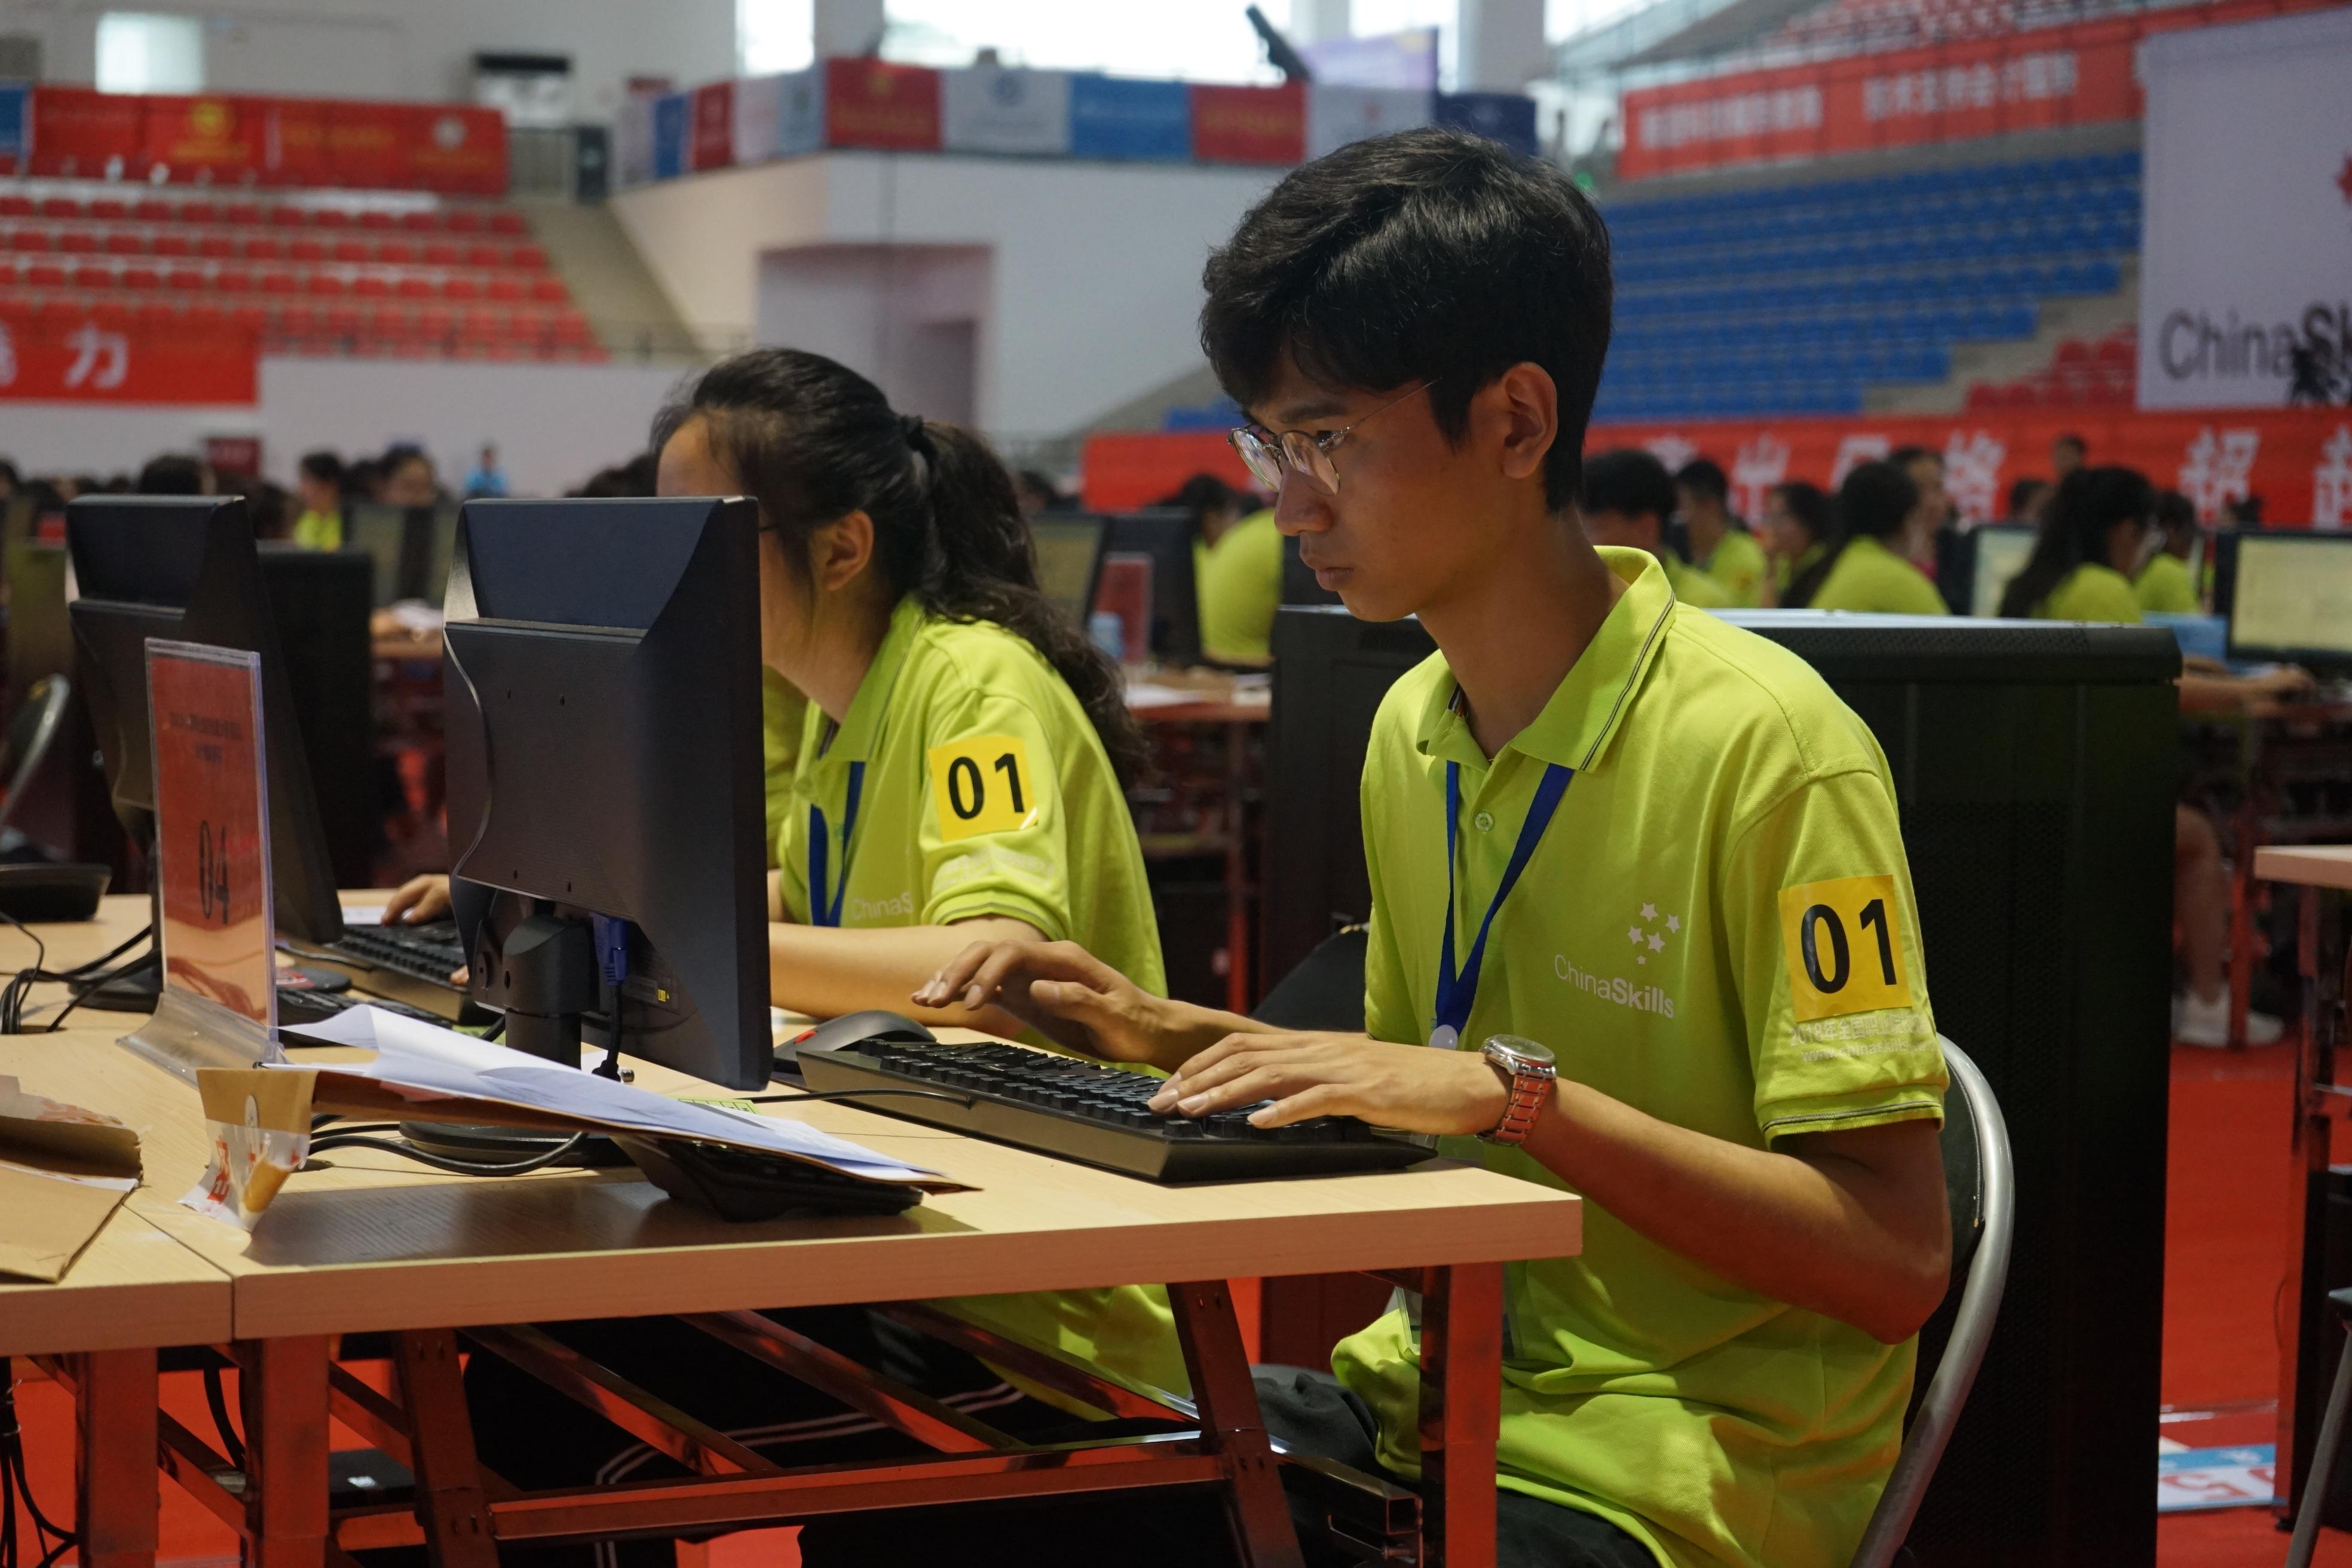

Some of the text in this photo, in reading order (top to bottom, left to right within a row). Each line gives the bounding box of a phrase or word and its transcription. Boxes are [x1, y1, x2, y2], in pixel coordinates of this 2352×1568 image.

[0, 320, 129, 389] 力
[948, 753, 1025, 820] 01
[199, 820, 229, 925] 04
[1800, 898, 1898, 994] 01
[1554, 954, 1674, 1019] ChinaSkills
